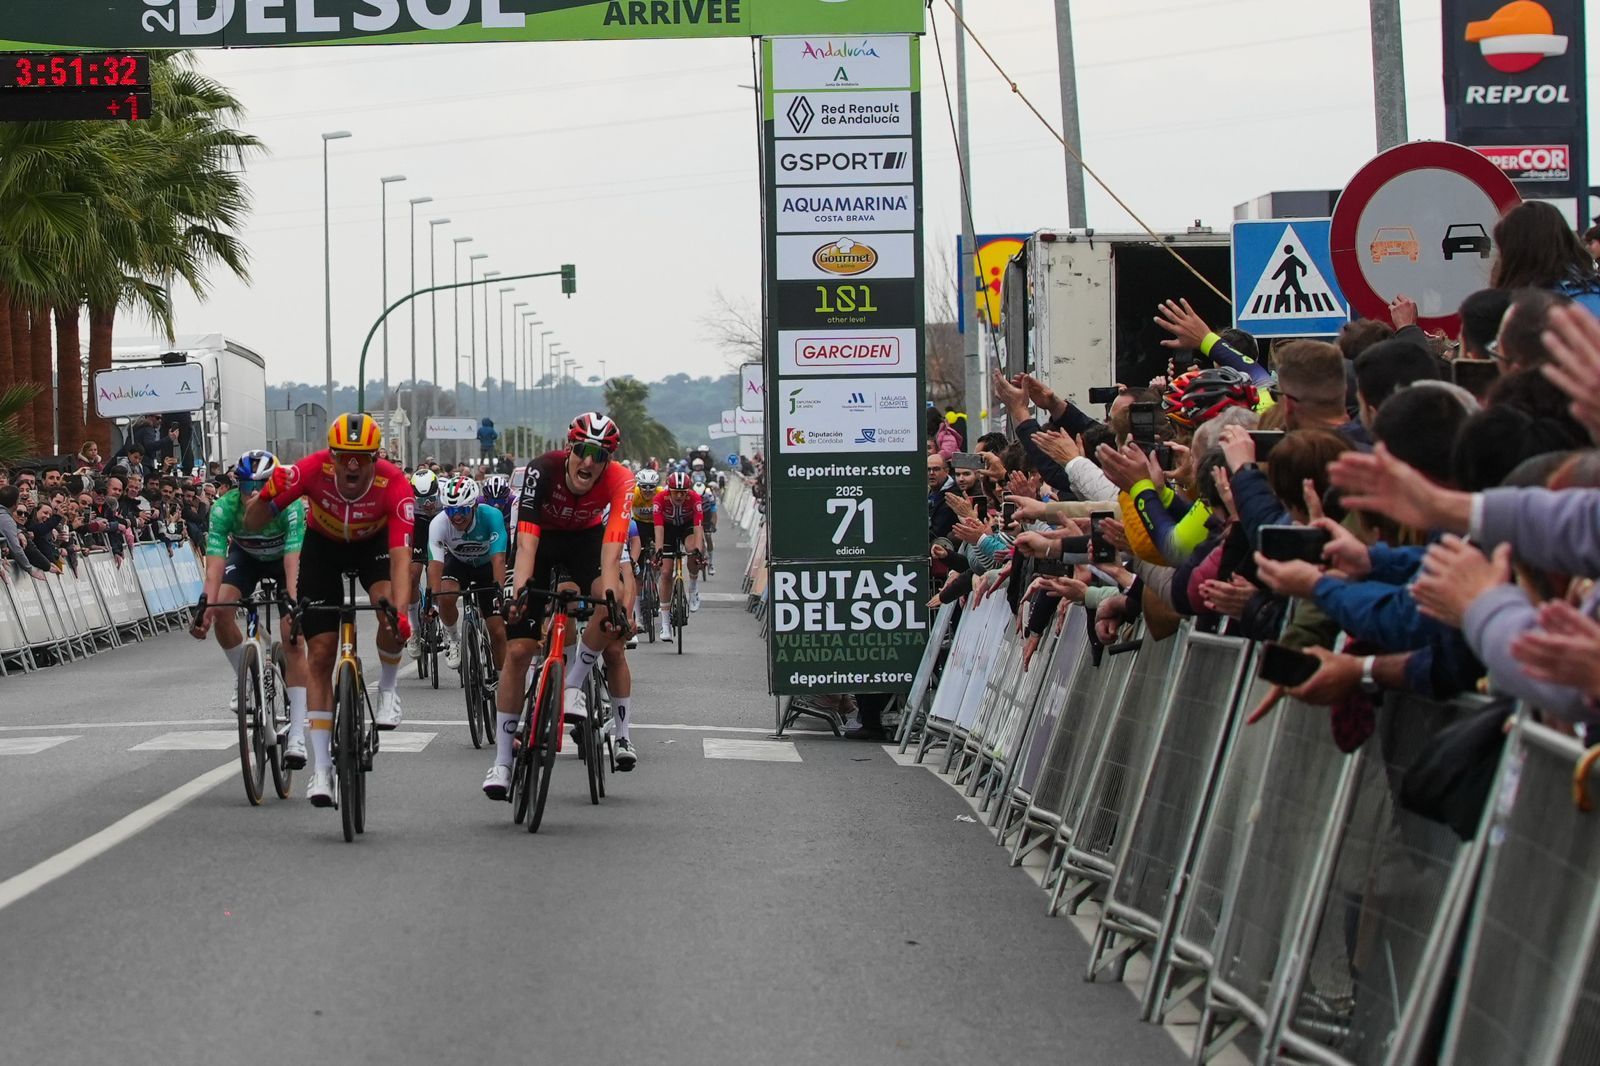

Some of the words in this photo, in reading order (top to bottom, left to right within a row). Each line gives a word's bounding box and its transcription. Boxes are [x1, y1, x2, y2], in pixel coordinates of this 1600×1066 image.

[802, 40, 880, 60] Andalucía
[16, 57, 137, 86] 3:51:32
[1466, 84, 1570, 104] REPSOL
[107, 95, 138, 121] +1
[821, 104, 846, 114] Red
[849, 102, 899, 113] Renault
[821, 115, 836, 125] de
[839, 114, 900, 124] Andalucía
[780, 152, 883, 171] GSPORT
[782, 197, 908, 213] AQUAMARINA
[846, 214, 875, 222] BRAVA
[820, 253, 870, 263] Gourmet
[827, 316, 848, 324] other
[802, 344, 892, 359] GARCIDEN
[100, 384, 160, 401] Andalucía
[808, 431, 843, 439] Diputación
[787, 464, 911, 480] deporinter.store
[521, 466, 541, 509] INEOS
[835, 486, 863, 497] 2025
[826, 498, 874, 545] 71
[835, 546, 866, 556] edición
[774, 569, 882, 601] RUTA
[775, 601, 846, 632] DEL
[850, 600, 926, 631] SOL
[775, 633, 842, 648] VUELTA
[848, 631, 926, 647] CICLISTA
[776, 648, 789, 663] A
[789, 671, 913, 687] deporinter.store
